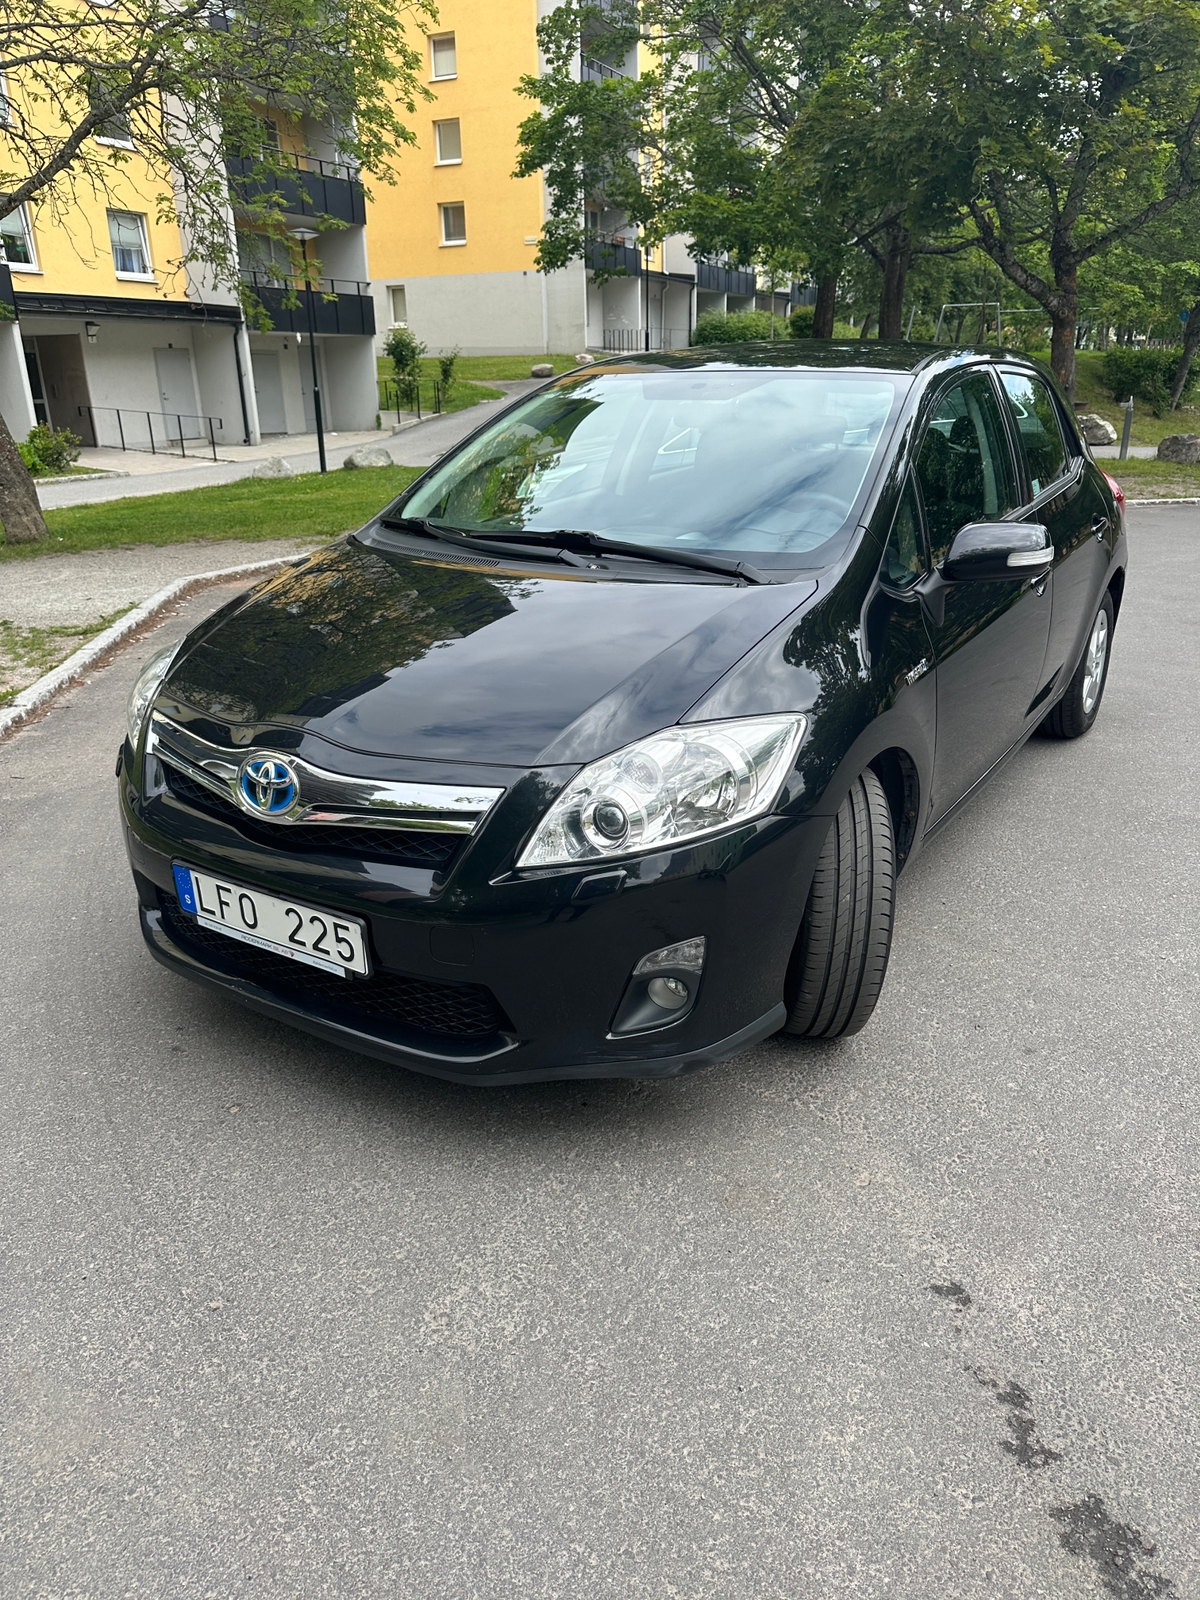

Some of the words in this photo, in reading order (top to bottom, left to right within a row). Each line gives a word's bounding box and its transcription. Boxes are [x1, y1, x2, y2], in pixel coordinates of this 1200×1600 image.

[184, 894, 191, 904] S
[194, 876, 258, 930] LFO
[284, 907, 355, 962] 225
